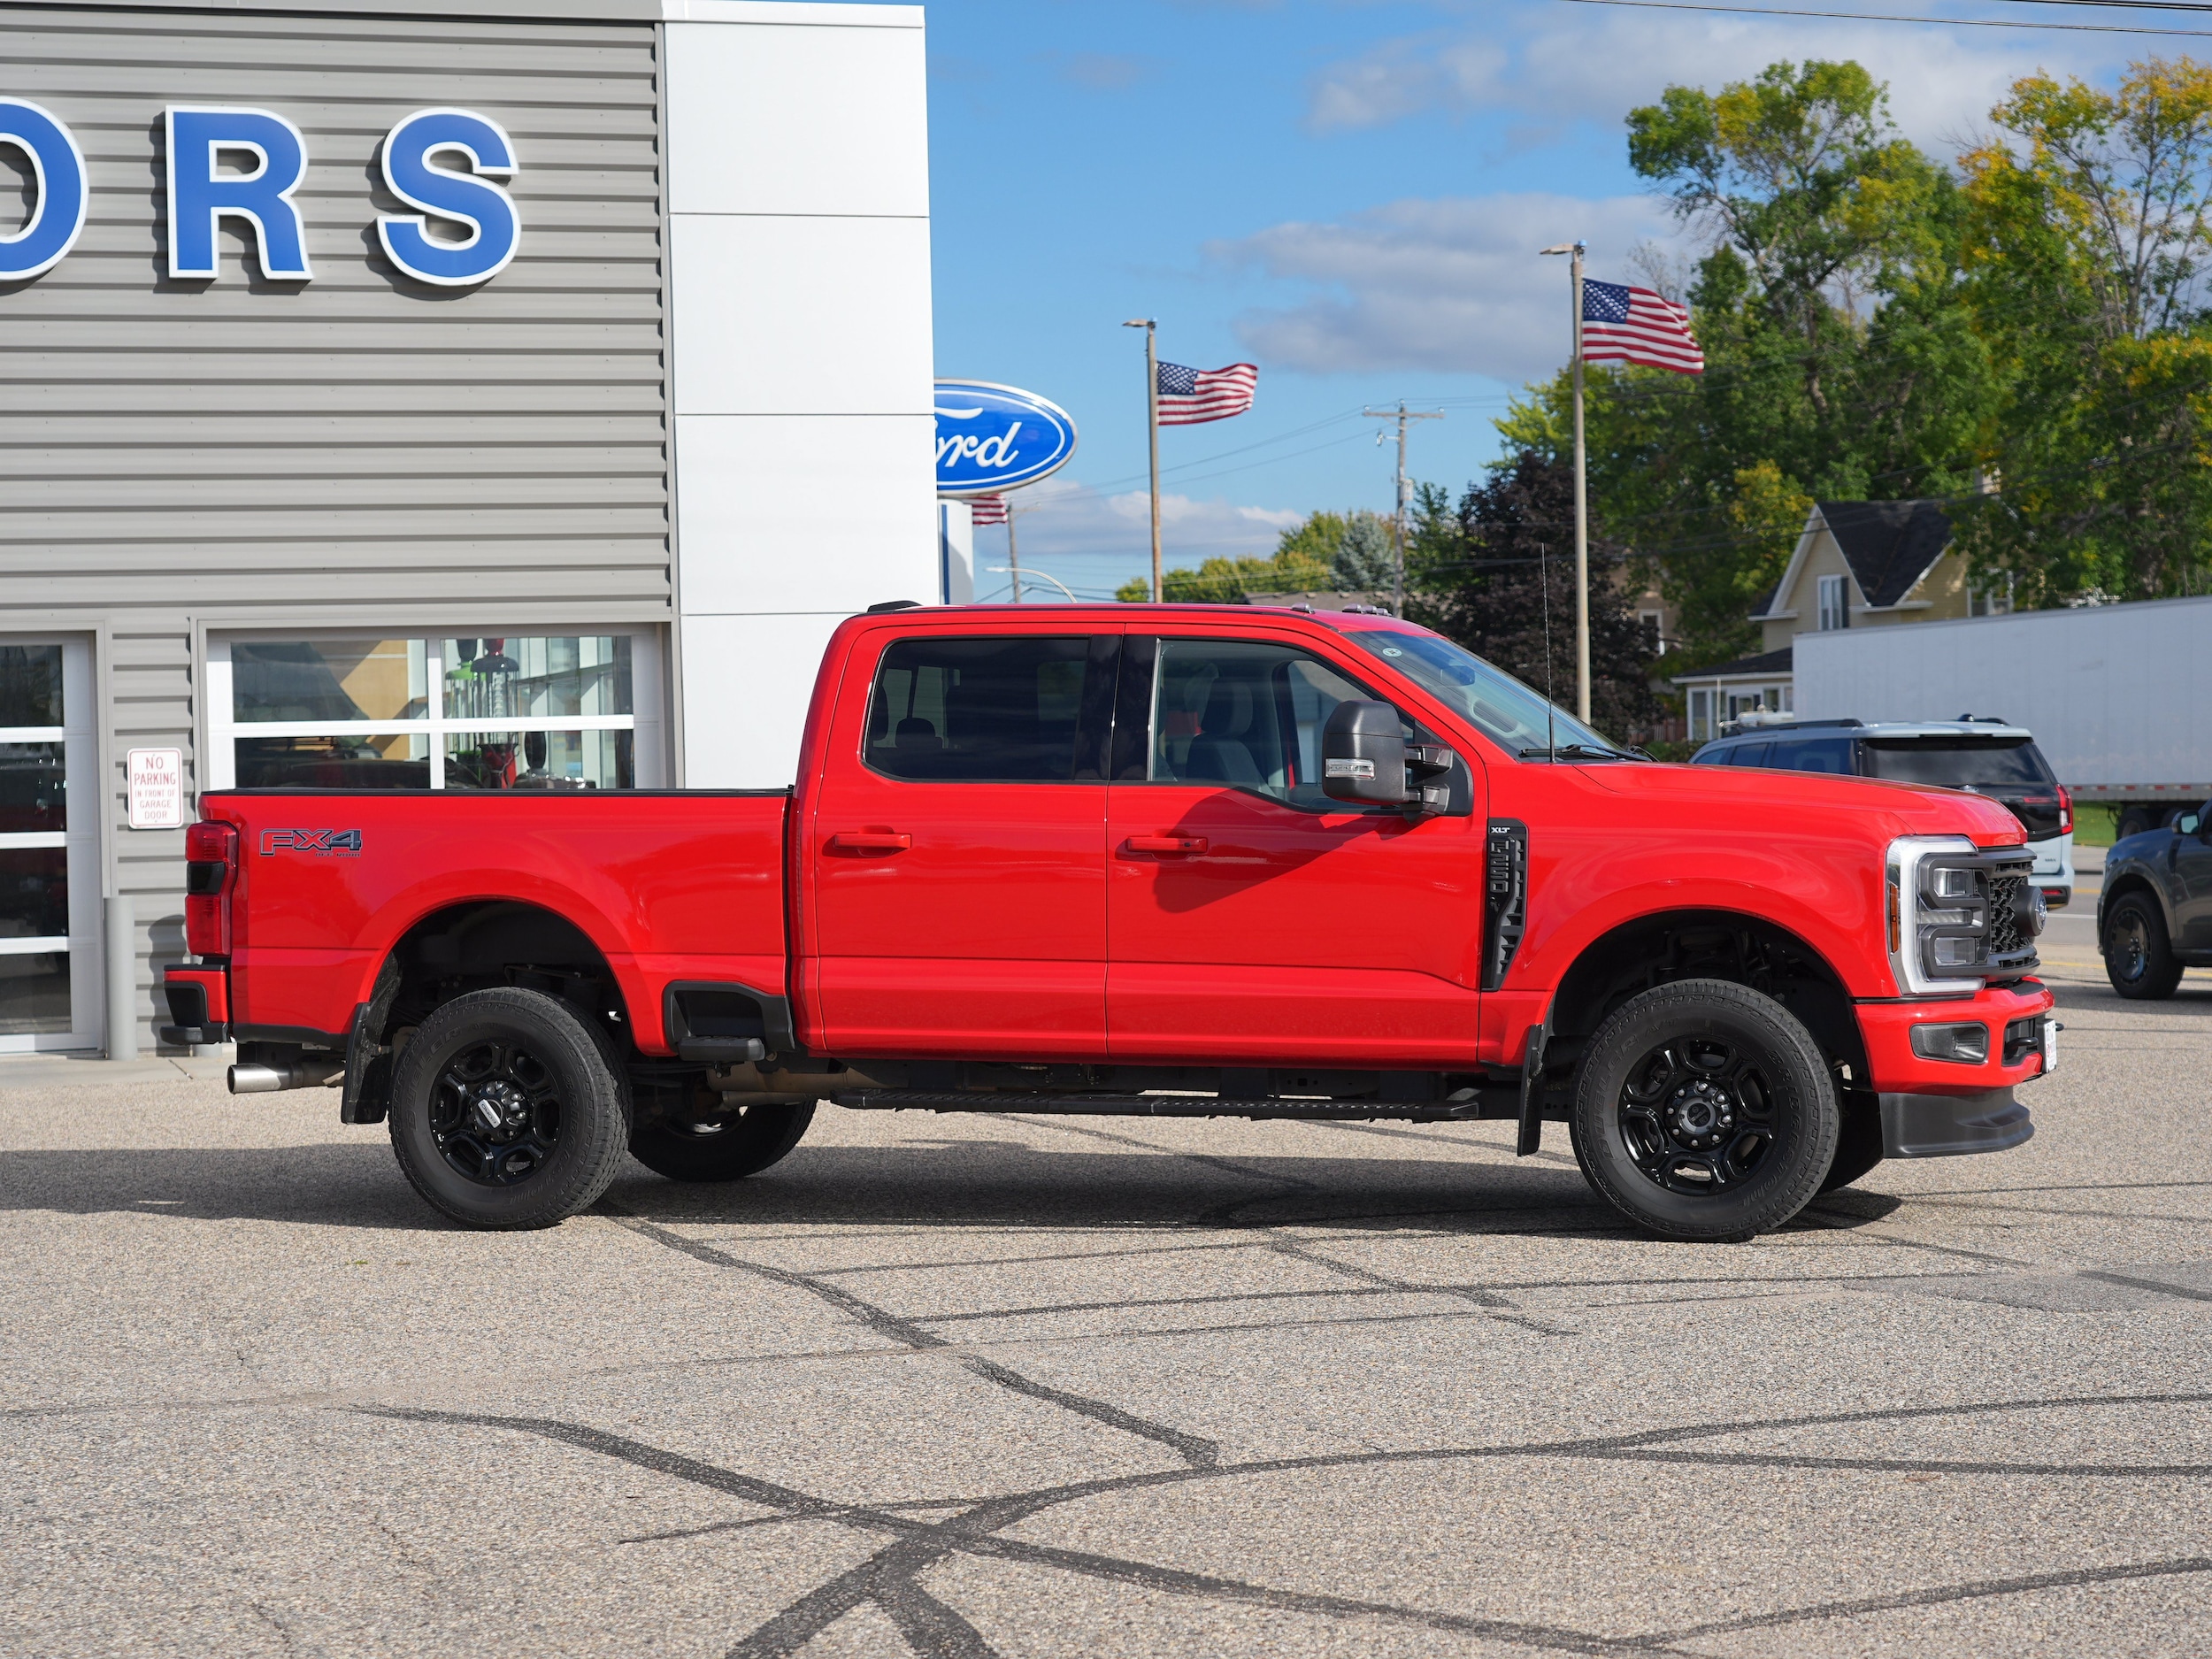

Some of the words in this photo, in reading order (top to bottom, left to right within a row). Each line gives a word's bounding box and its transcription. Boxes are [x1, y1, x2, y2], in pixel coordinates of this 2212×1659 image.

[145, 757, 164, 770] NO
[134, 772, 176, 785] PARKING
[139, 799, 172, 809] GARAGE
[144, 810, 167, 819] DOOR
[260, 829, 361, 856] FX4
[406, 1025, 461, 1132] DUELER
[1594, 1033, 1639, 1160] DUELER
[1736, 1048, 1801, 1211] BRIDGESTONE
